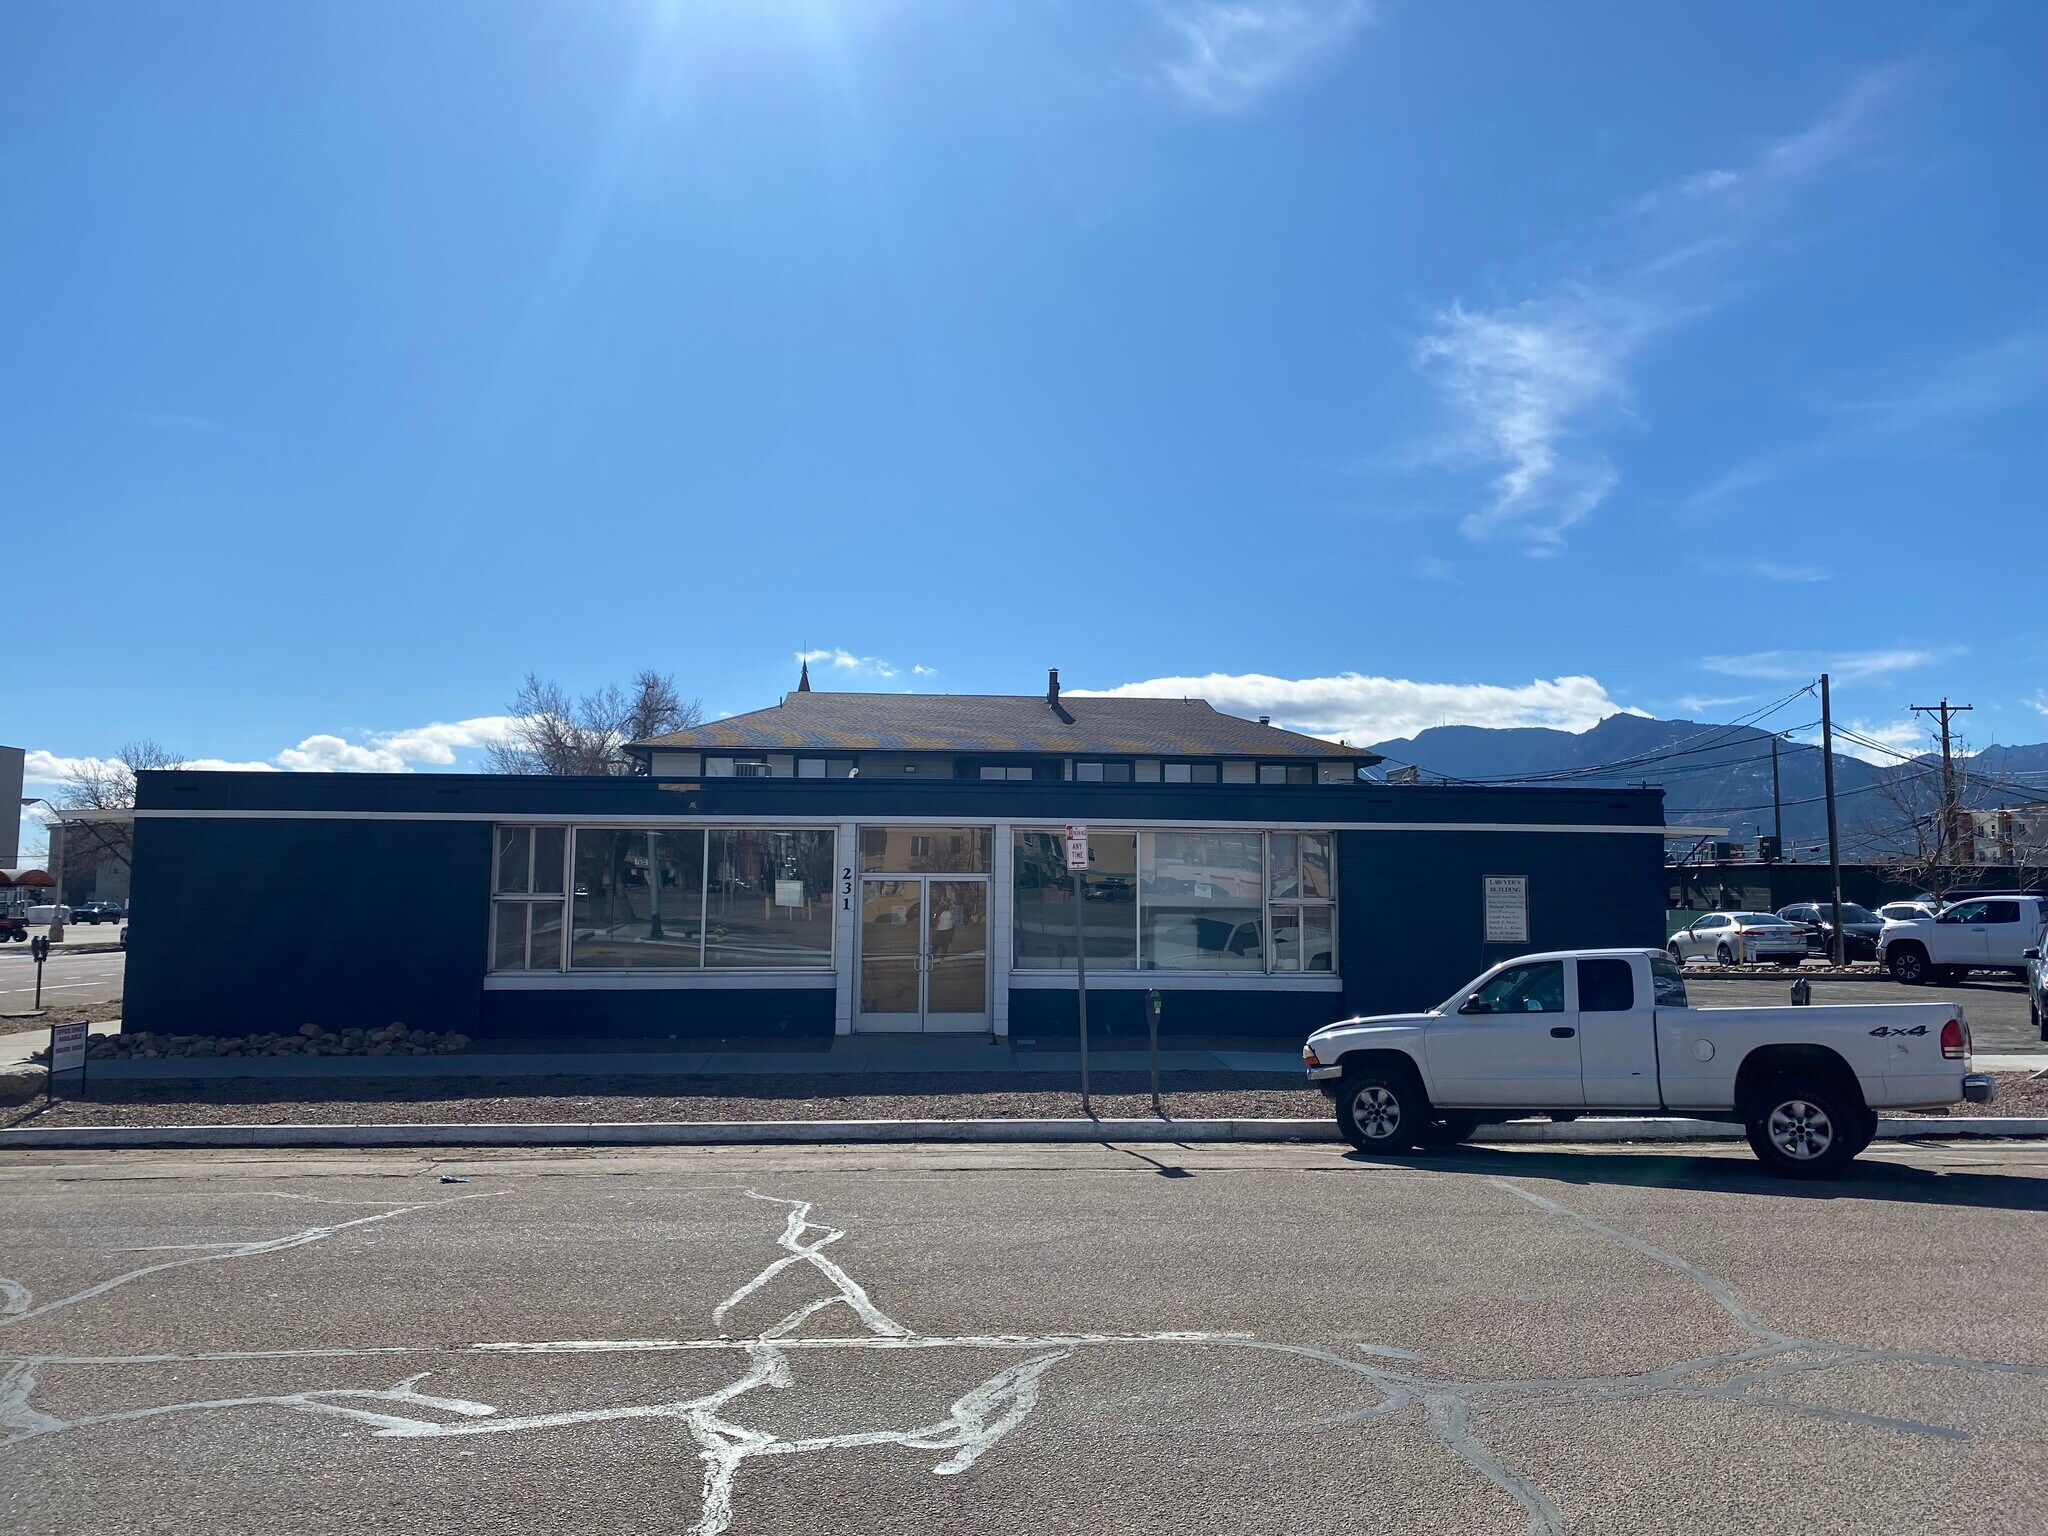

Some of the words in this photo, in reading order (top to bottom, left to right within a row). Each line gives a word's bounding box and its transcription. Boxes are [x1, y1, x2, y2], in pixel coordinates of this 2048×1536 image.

[1072, 851, 1084, 859] TIME
[842, 867, 852, 911] 231
[1868, 1025, 1930, 1038] 4x4
